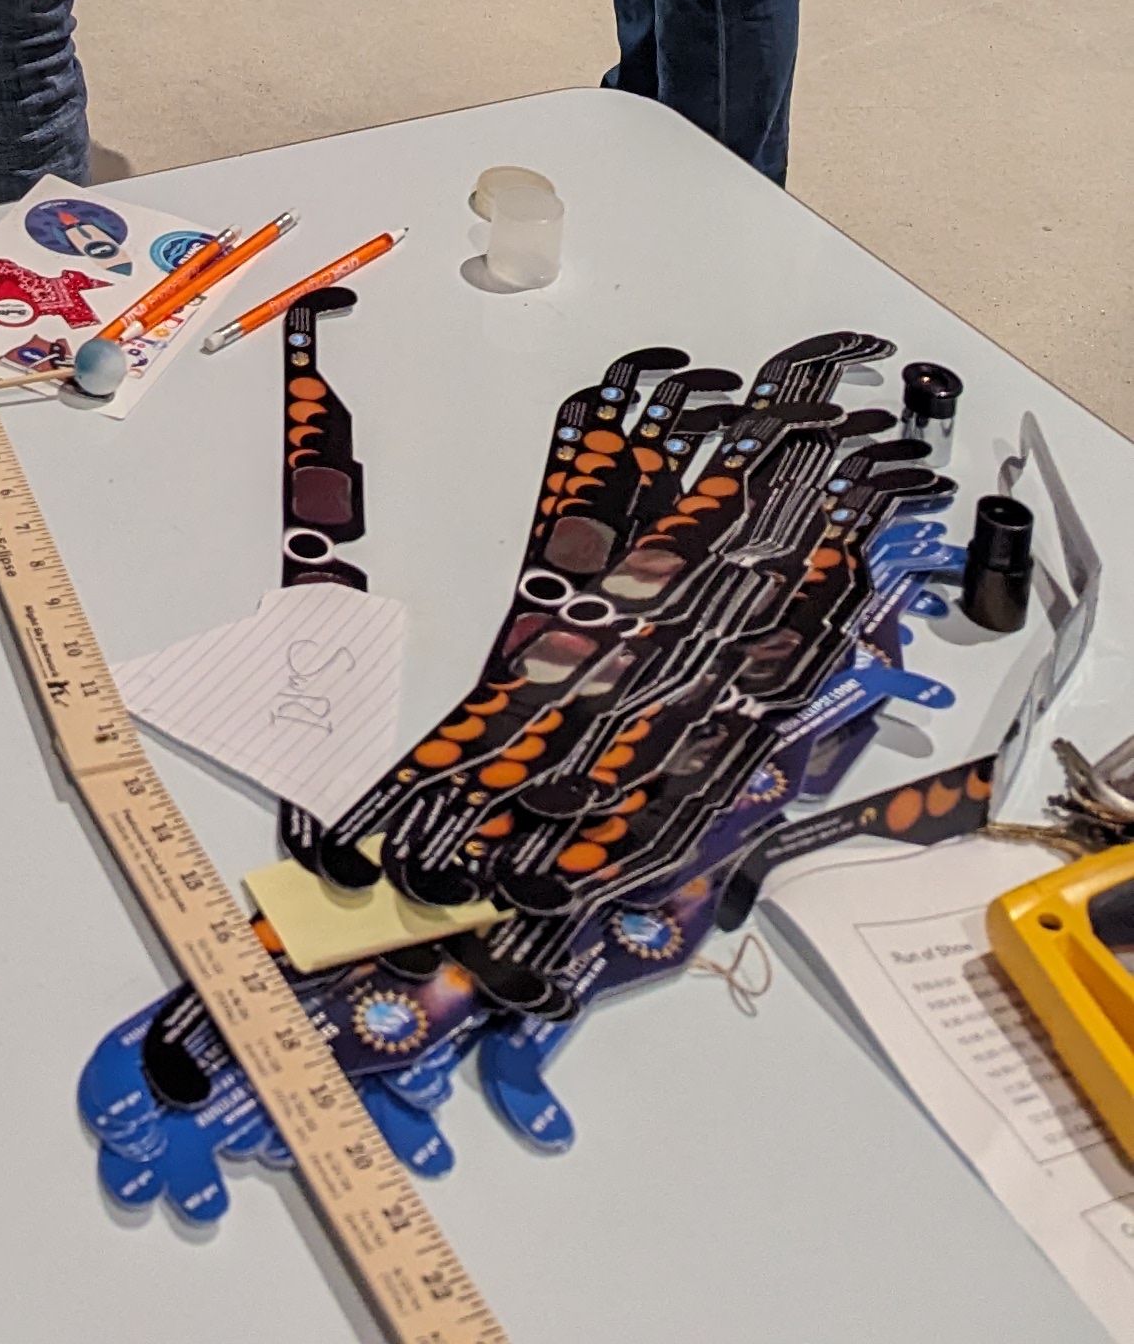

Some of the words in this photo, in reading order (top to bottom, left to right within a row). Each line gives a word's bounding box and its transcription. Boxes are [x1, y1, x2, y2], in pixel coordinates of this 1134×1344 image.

[0, 489, 14, 498] 6
[15, 523, 30, 533] 7
[30, 560, 45, 570] 8
[46, 598, 61, 609] 9
[34, 627, 43, 641] Sky
[40, 643, 59, 677] Network
[63, 641, 83, 657] 10
[80, 680, 100, 697] 11
[123, 777, 146, 796] 13
[152, 816, 174, 843] 14
[210, 913, 235, 944] 16
[891, 952, 920, 963] Run
[935, 944, 973, 957] Show
[241, 965, 268, 993] 17
[274, 1020, 301, 1051] 18
[309, 1078, 336, 1109] 19
